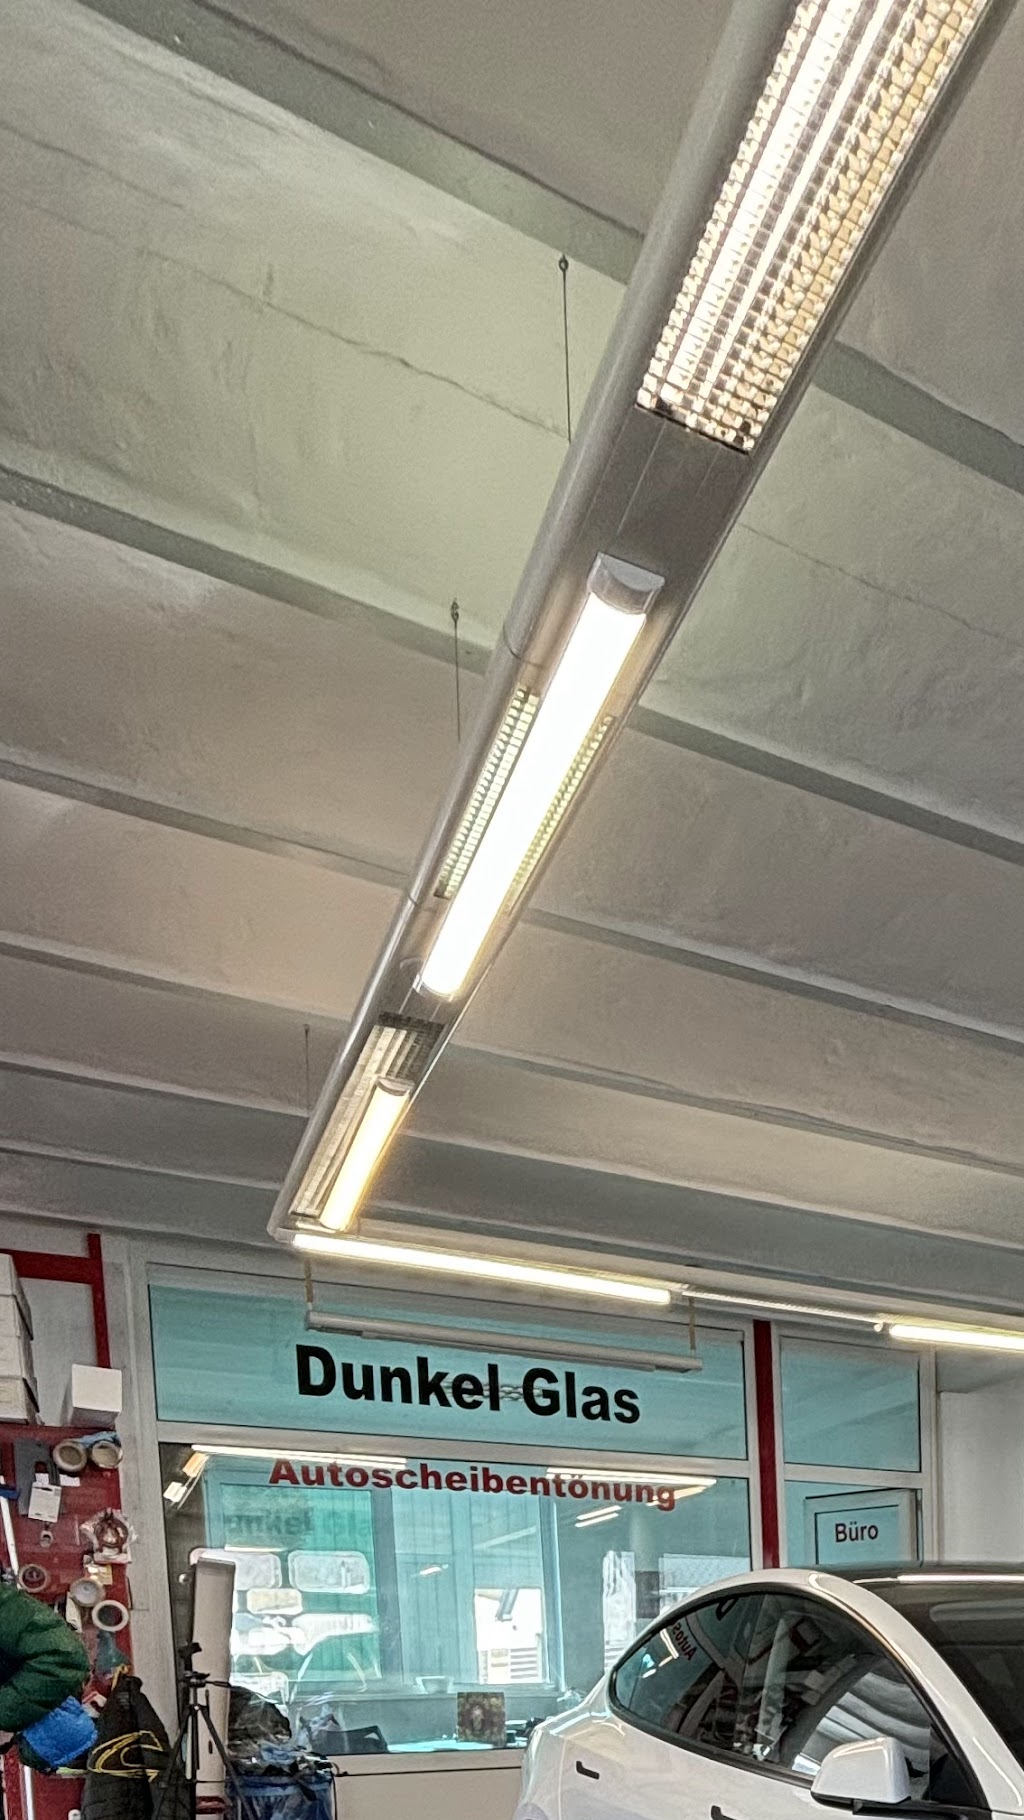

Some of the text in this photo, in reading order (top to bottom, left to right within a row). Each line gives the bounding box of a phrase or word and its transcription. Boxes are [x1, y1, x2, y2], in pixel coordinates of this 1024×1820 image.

[296, 1344, 640, 1424] Dunkel Glas
[268, 1458, 676, 1512] Autoscheibentönung
[835, 1521, 879, 1543] Büro
